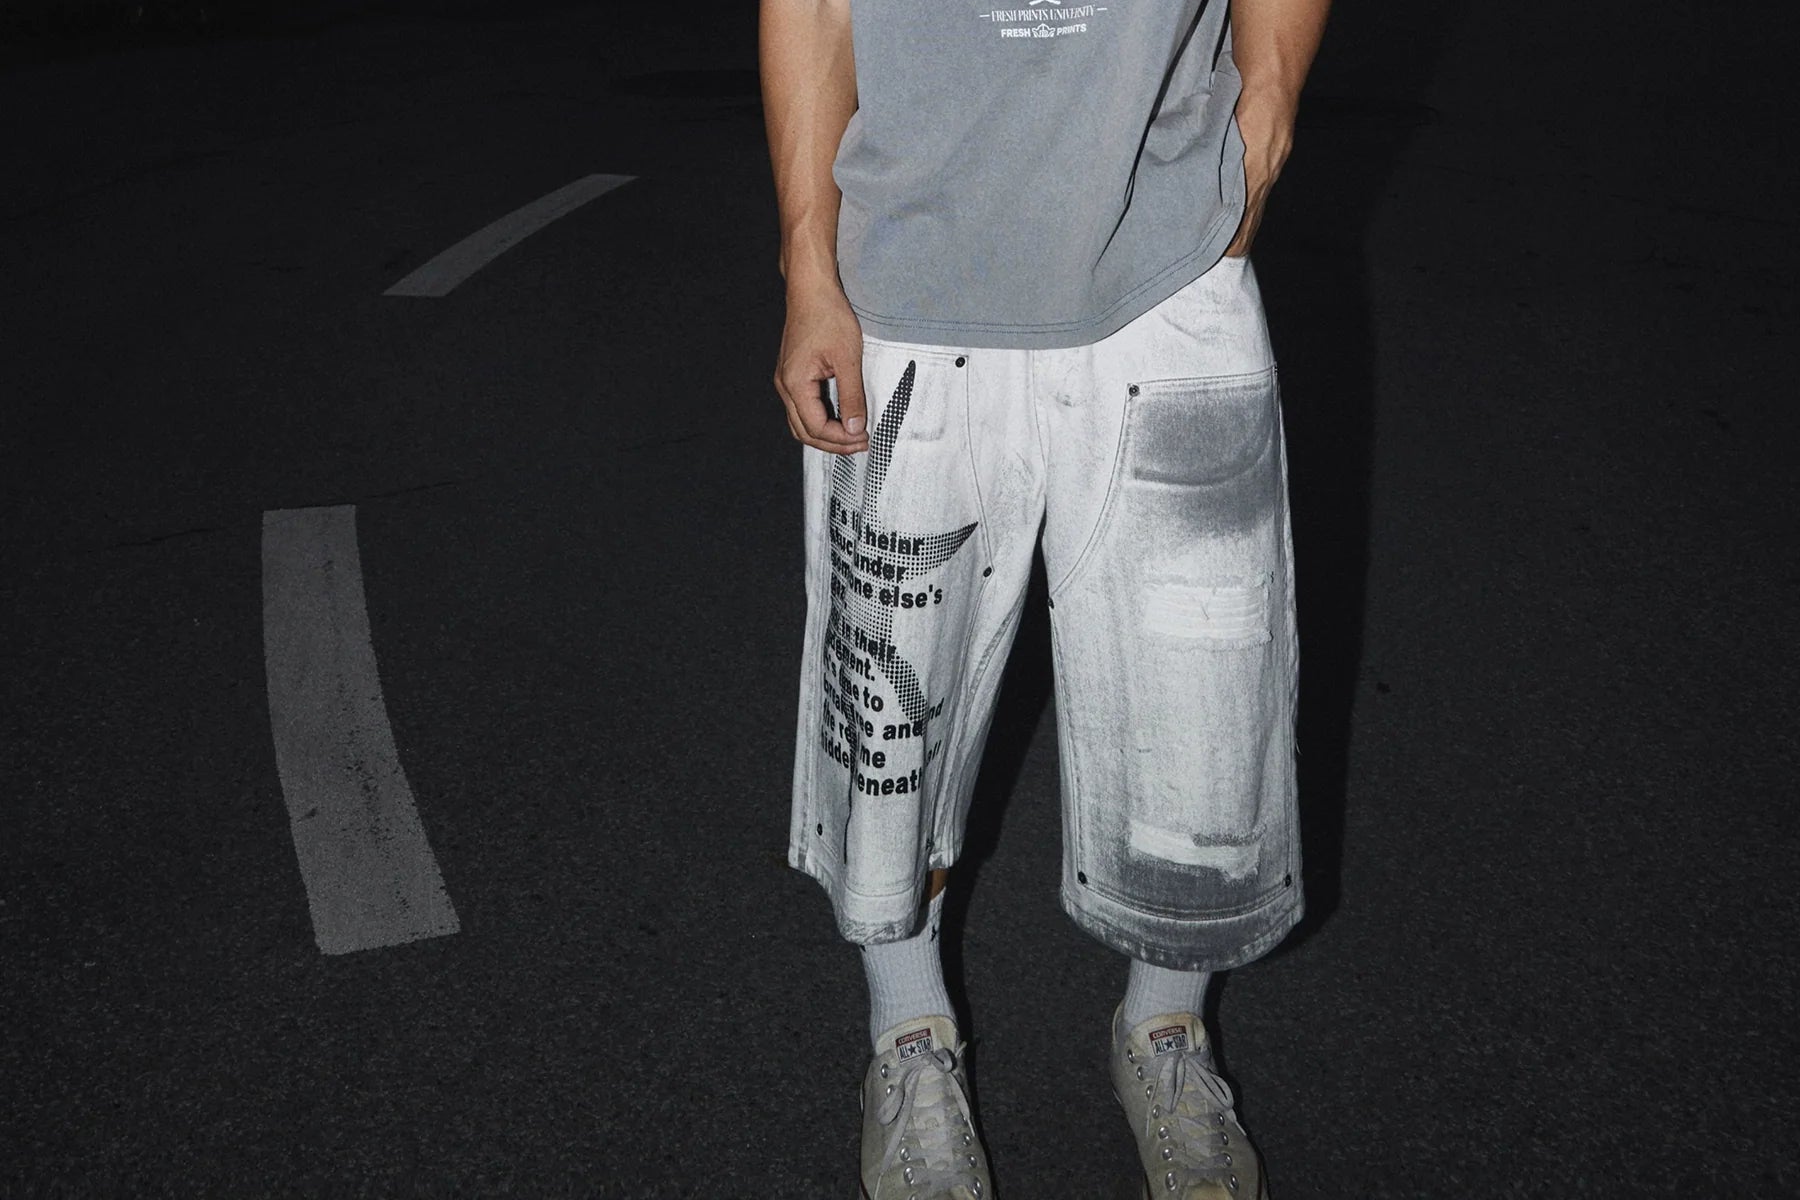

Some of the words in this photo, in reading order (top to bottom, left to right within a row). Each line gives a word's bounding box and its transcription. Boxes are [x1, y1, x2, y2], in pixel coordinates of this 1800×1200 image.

[1018, 8, 1049, 21] PRINTS
[1001, 28, 1032, 38] FRESH
[1056, 23, 1087, 36] PRINTS
[879, 584, 943, 609] else's
[863, 686, 884, 712] to
[882, 718, 924, 741] and
[860, 743, 886, 769] me
